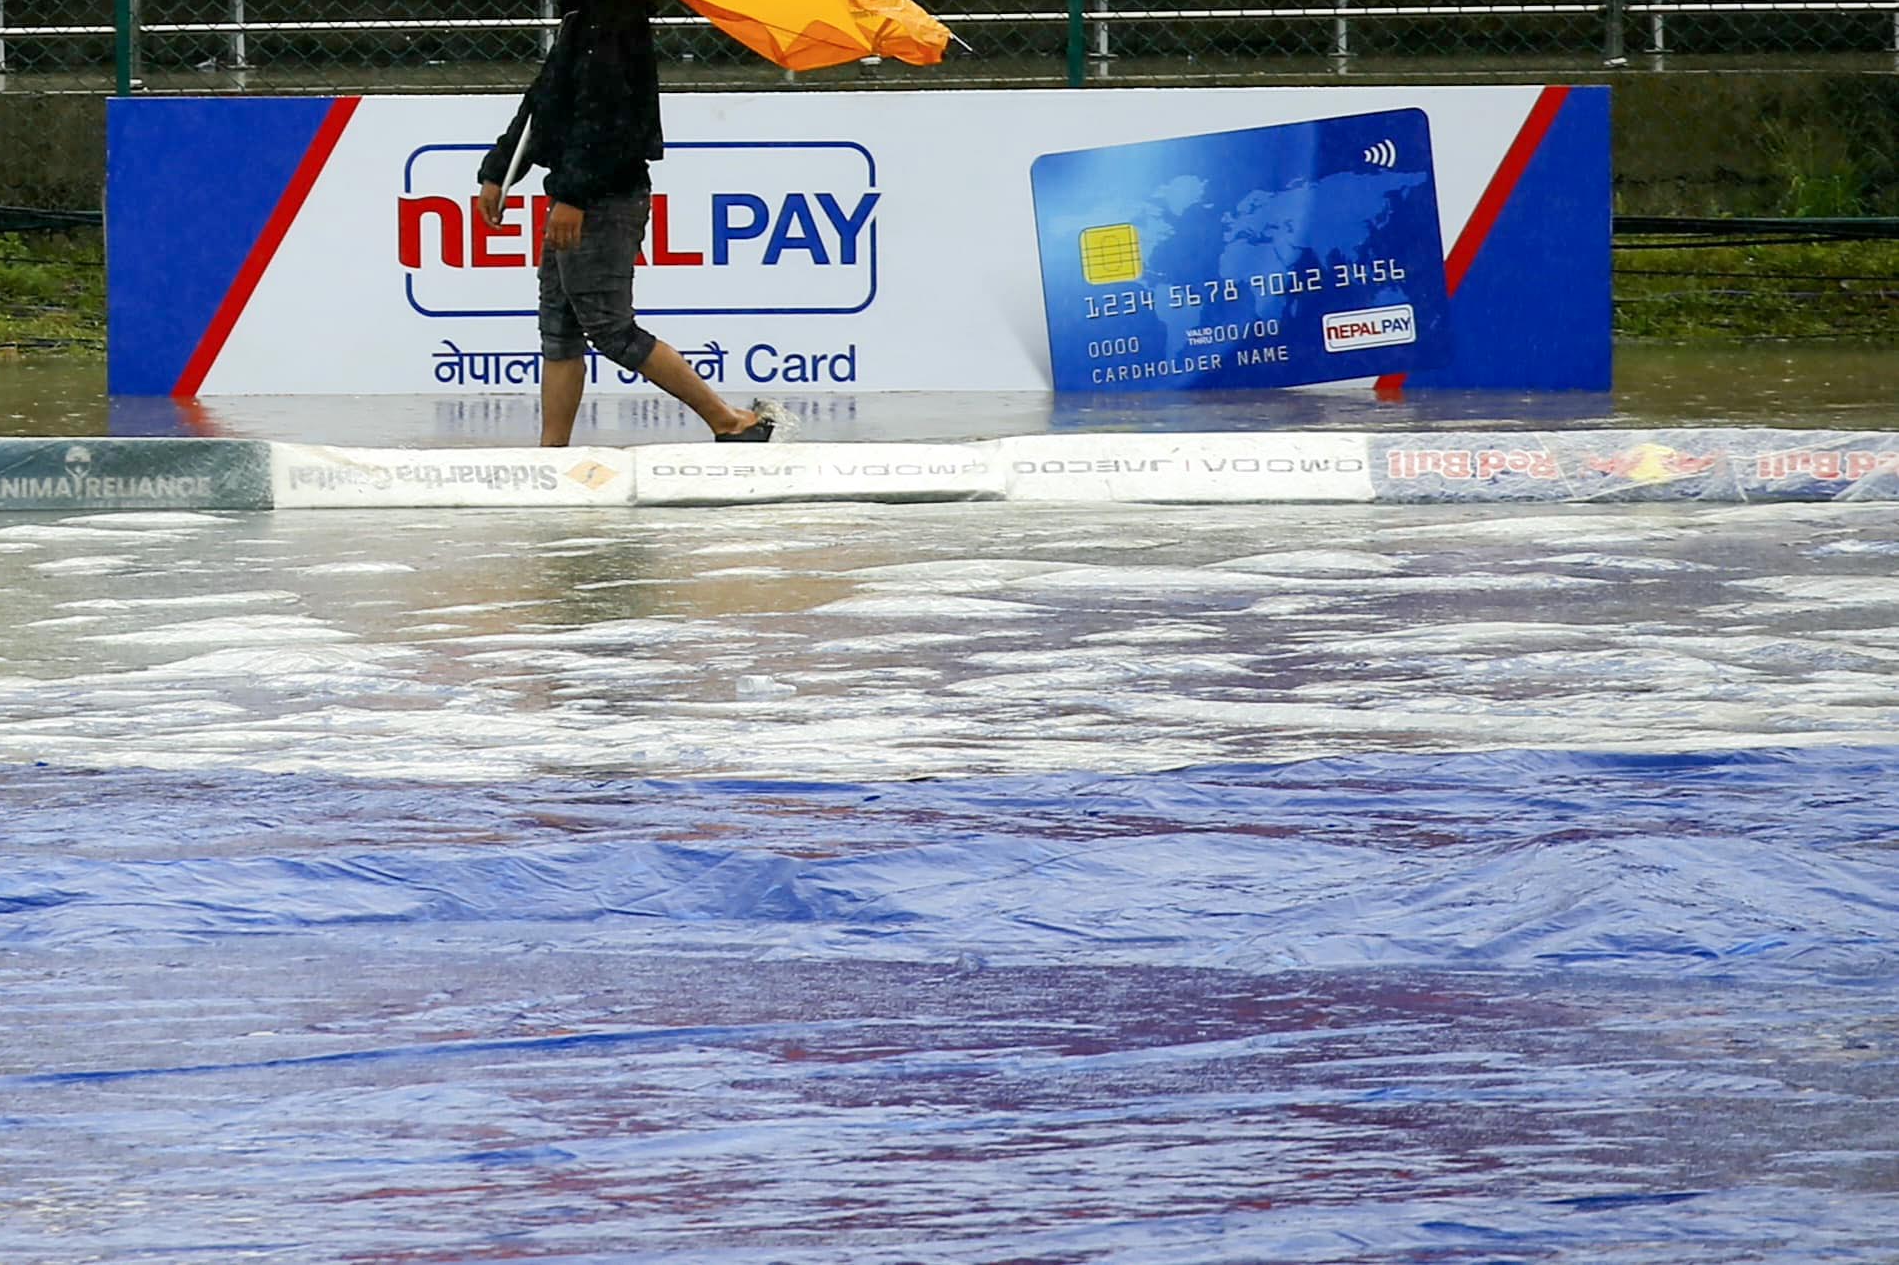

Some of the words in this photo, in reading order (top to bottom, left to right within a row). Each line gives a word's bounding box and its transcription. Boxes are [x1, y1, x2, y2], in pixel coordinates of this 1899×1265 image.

[1084, 290, 1155, 319] 1234
[1169, 279, 1238, 307] 5678
[1250, 268, 1322, 296] 9012
[1334, 259, 1405, 287] 3456
[1186, 328, 1213, 337] VALID
[1189, 336, 1213, 346] THRU
[1214, 319, 1279, 342] 00/00
[1088, 336, 1140, 358] 0000
[745, 344, 856, 383] Card
[1092, 353, 1222, 384] CARDHOLDER
[1237, 345, 1289, 366] NAME
[396, 464, 559, 491] Siddhartha
[1386, 449, 1473, 480] Bull
[1476, 449, 1561, 480] Red
[85, 476, 212, 498] RELIANCE
